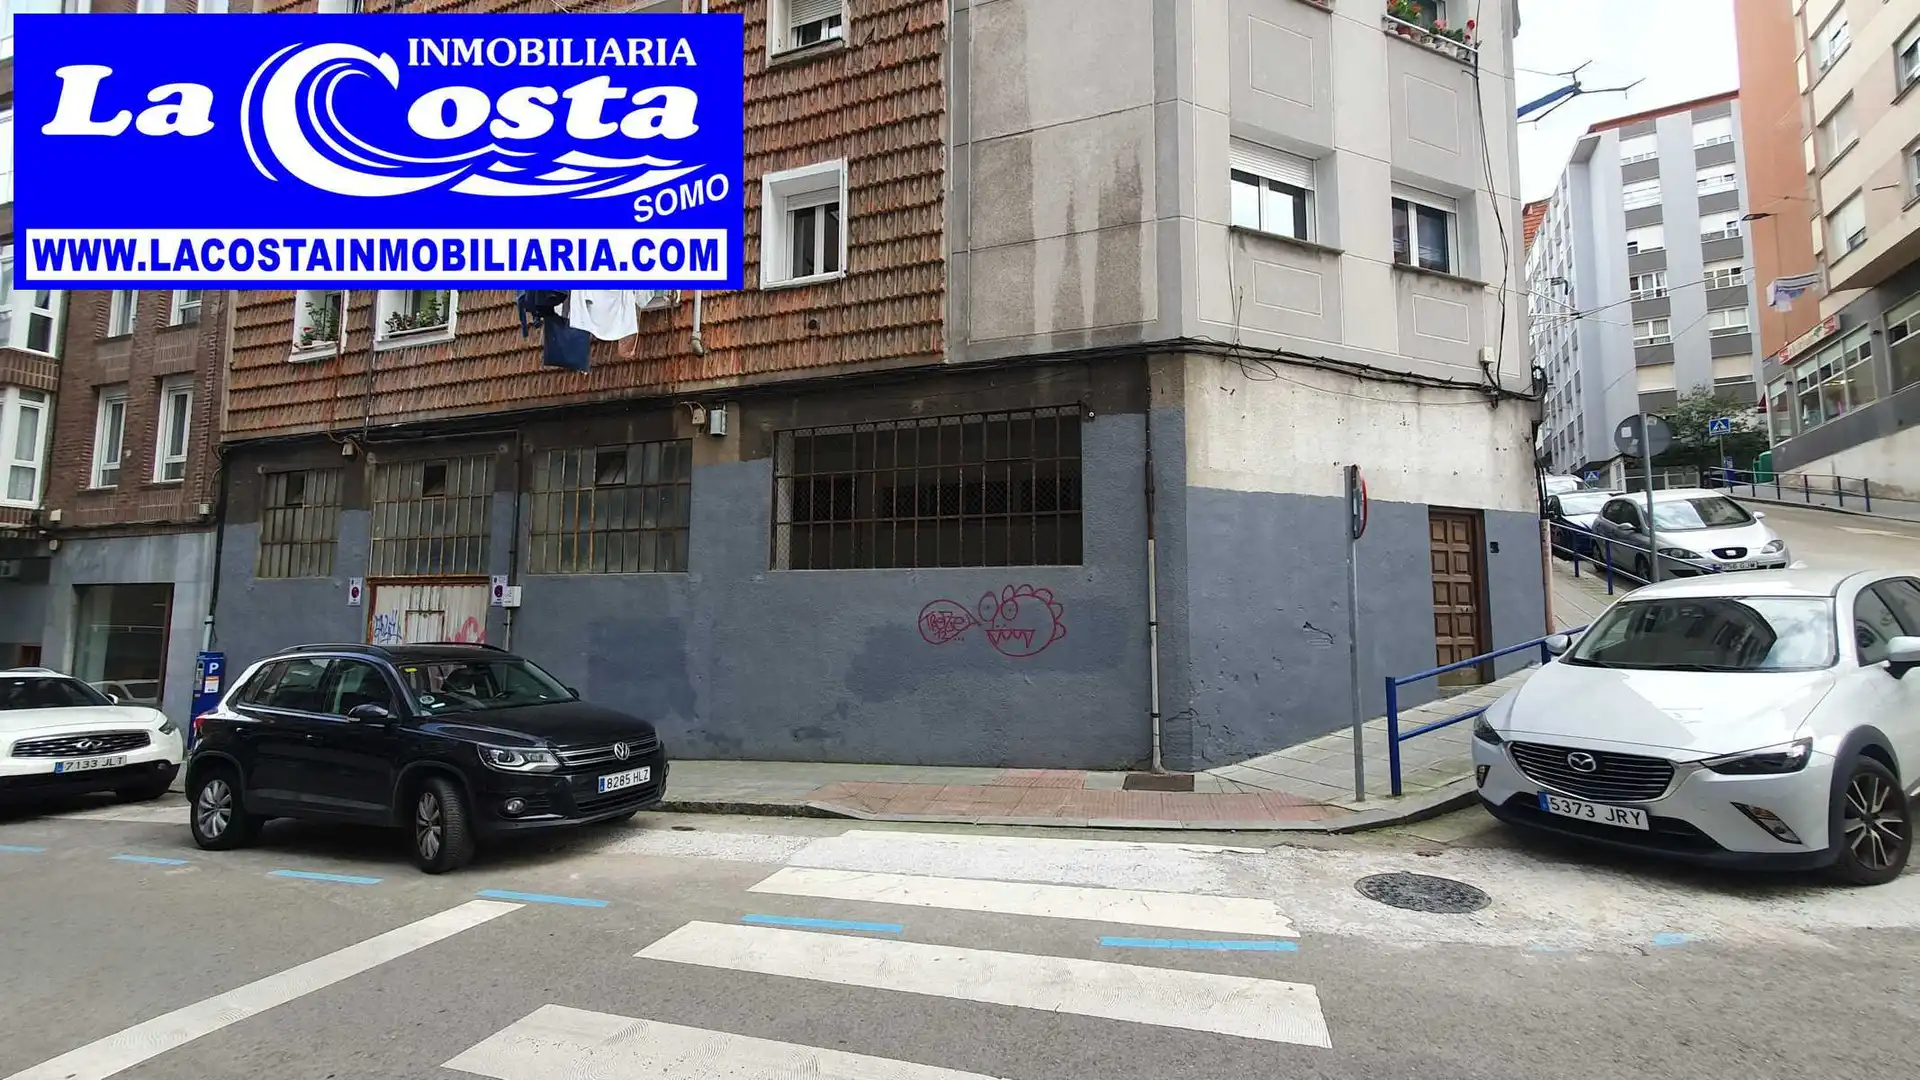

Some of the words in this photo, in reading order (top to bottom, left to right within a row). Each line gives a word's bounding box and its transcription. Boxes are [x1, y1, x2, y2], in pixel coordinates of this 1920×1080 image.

[209, 662, 219, 674] P
[65, 760, 98, 771] 7133
[606, 773, 631, 789] 8285
[633, 769, 649, 783] HLZ
[1549, 798, 1596, 819] 5373
[1605, 807, 1641, 826] JRY
